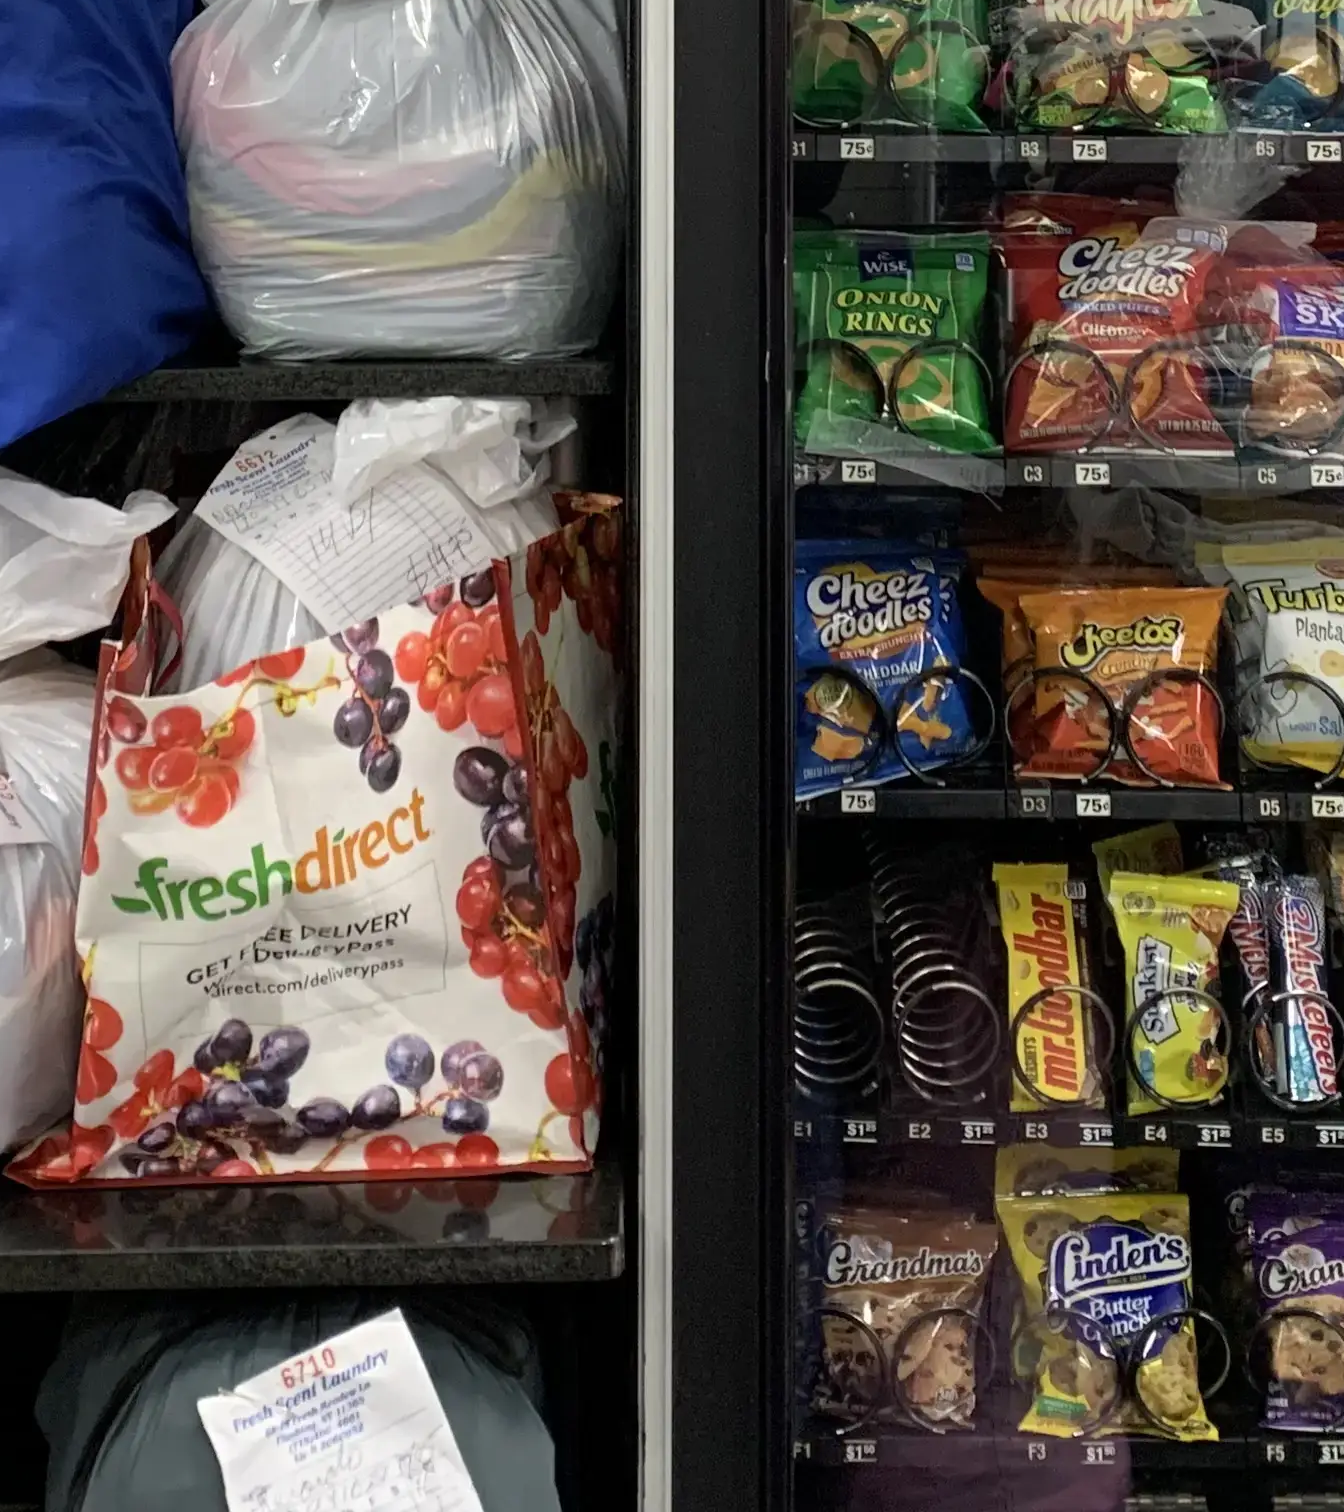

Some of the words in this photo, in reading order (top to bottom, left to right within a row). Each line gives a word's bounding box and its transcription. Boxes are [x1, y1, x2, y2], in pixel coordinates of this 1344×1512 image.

[1020, 141, 1040, 157] B3
[1076, 143, 1106, 158] 75¢
[1256, 141, 1275, 157] B5
[1311, 145, 1341, 159] 75¢
[1059, 238, 1197, 277] Cheez
[863, 260, 908, 274] WISE
[1058, 268, 1186, 299] doodles
[836, 288, 943, 315] ONION
[844, 311, 933, 337] RINGS
[268, 434, 318, 470] Laundry
[235, 449, 279, 473] 6672
[845, 465, 874, 480] 75¢
[1023, 466, 1043, 482] C3
[1080, 466, 1110, 481] 75¢
[1258, 469, 1277, 484] C5
[1313, 470, 1343, 485] 75¢
[807, 571, 931, 617] Cheez
[820, 596, 933, 647] doodles
[1060, 615, 1183, 671] Cheetos
[845, 796, 875, 810] 75¢
[1023, 796, 1046, 811] D3
[1081, 799, 1110, 814] 75¢
[1260, 800, 1280, 816] D5
[1316, 801, 1344, 815] 75¢
[132, 786, 432, 922] freshdirect
[186, 953, 234, 985] GET
[301, 903, 413, 940] DELIVERY
[794, 1123, 813, 1138] E1
[909, 1125, 931, 1139] E2
[1025, 1124, 1048, 1139] E3
[1145, 1126, 1167, 1141] E4
[1262, 1128, 1285, 1143] E5
[823, 1241, 983, 1286] Grandma's
[1050, 1228, 1191, 1296] Linden's
[1090, 1294, 1153, 1320] Butter
[281, 1347, 336, 1389] 6710
[232, 1403, 273, 1433] Fresh
[321, 1348, 389, 1391] Laundry
[794, 1445, 811, 1460] F1
[1029, 1445, 1046, 1460] F3
[1267, 1446, 1284, 1461] F5
